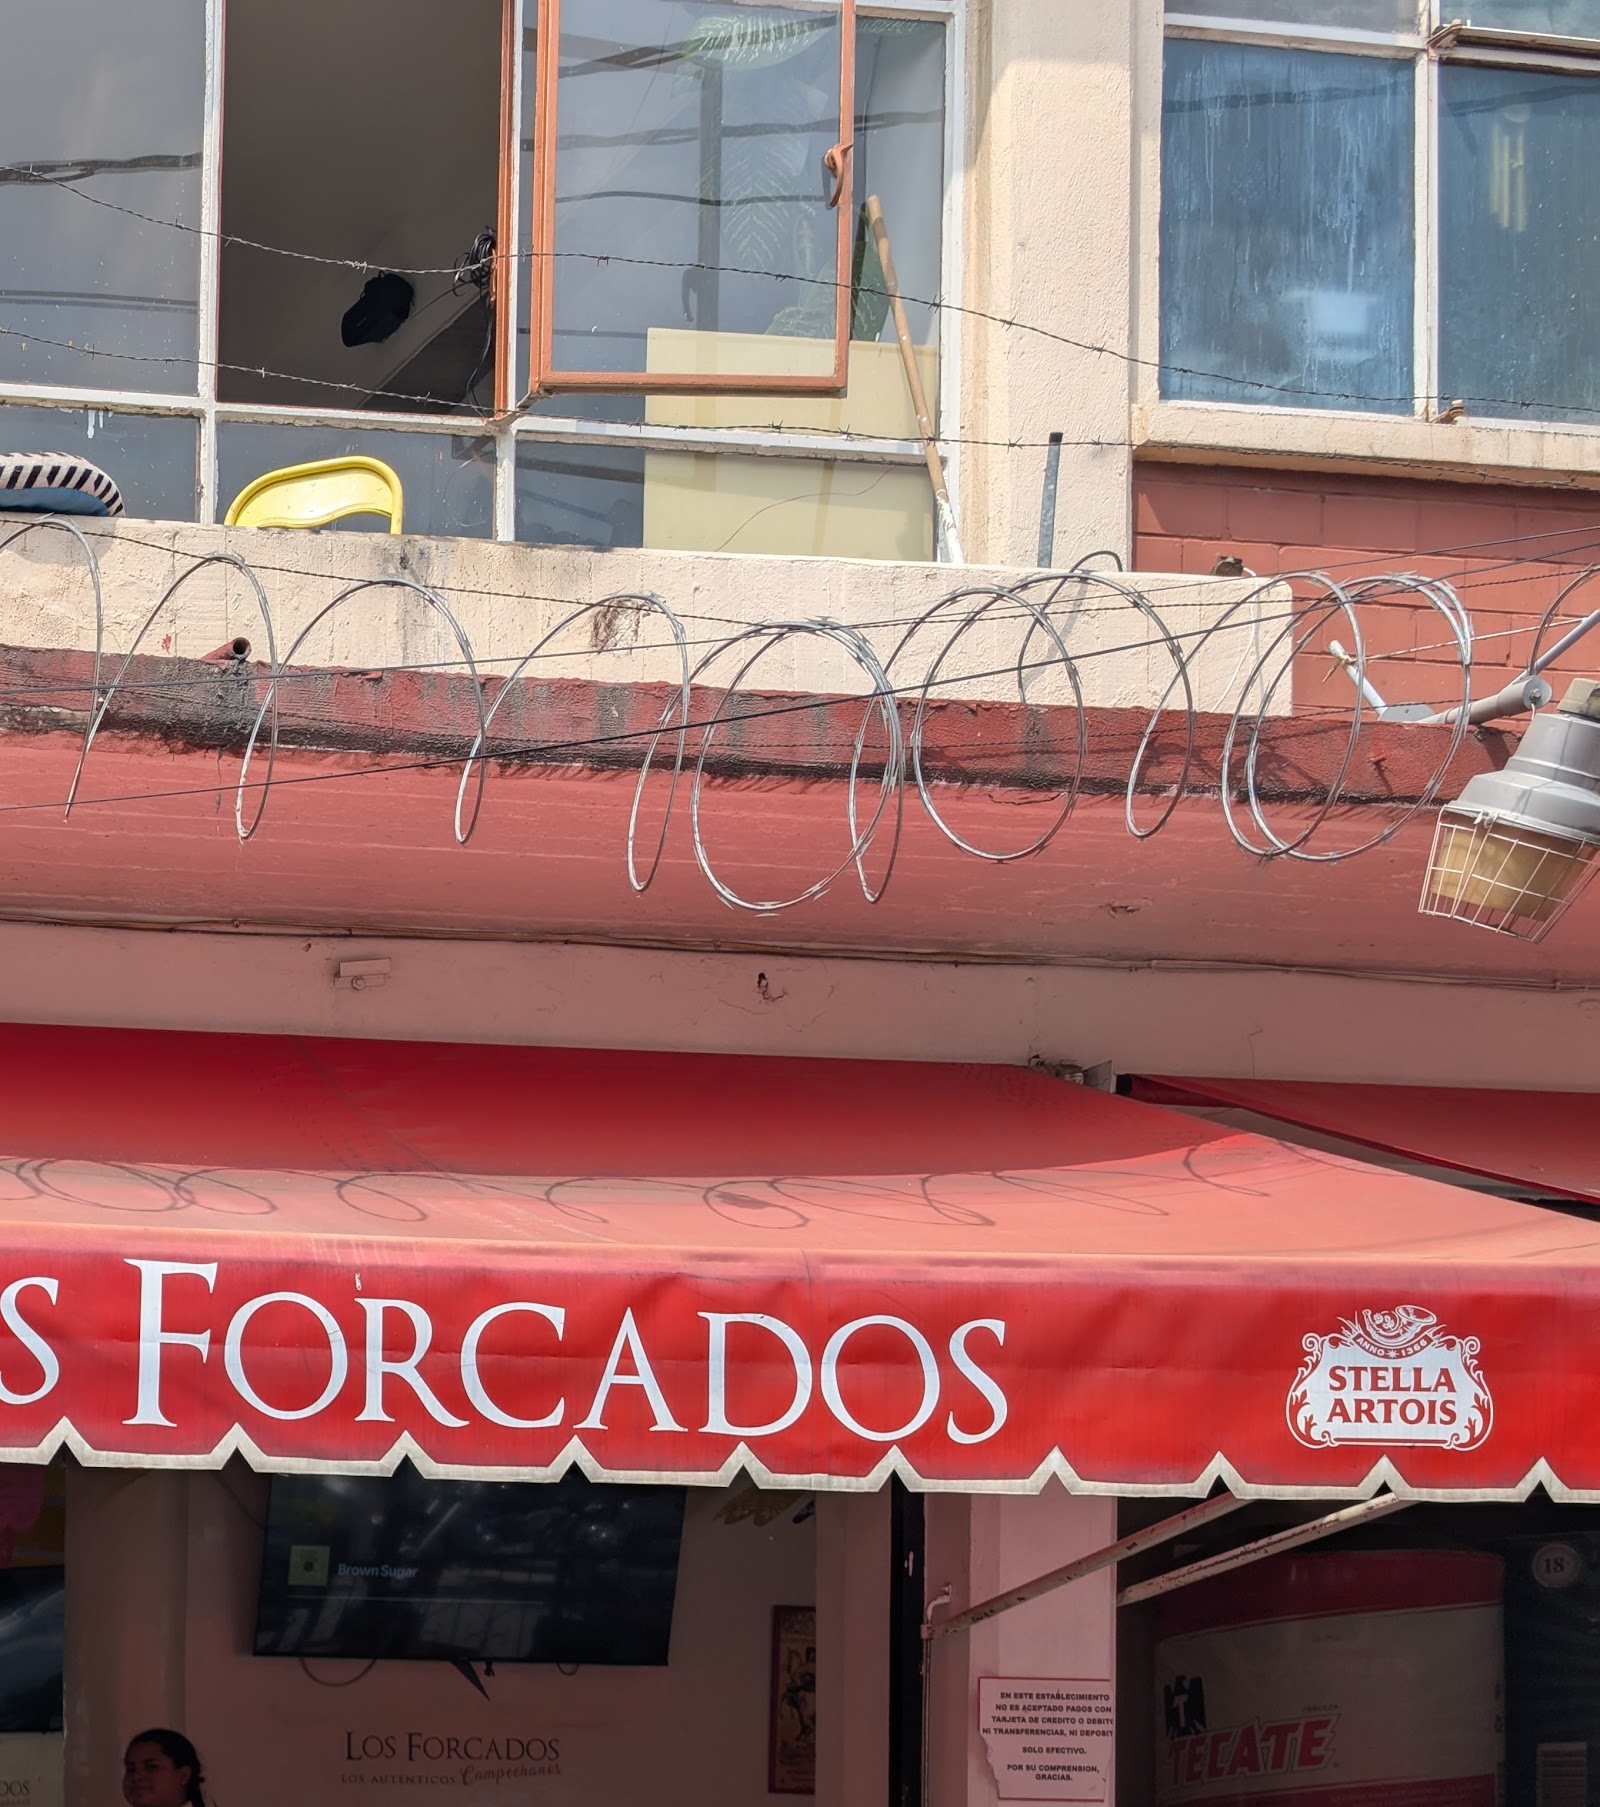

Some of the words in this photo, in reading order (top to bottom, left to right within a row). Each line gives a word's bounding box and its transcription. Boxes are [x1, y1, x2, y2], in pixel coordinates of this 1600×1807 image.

[119, 1256, 1011, 1447] FORCADOS
[1356, 1337, 1384, 1356] ANNO
[1401, 1339, 1427, 1356] 1366
[1329, 1366, 1457, 1392] STELLA
[1327, 1398, 1457, 1425] ARTOIS
[1544, 1557, 1565, 1574] 18
[1036, 1693, 1110, 1701] ESTABLECIMIENTO
[993, 1728, 1067, 1737] TRANSFERENCIAS,
[345, 1731, 396, 1760] LOS
[407, 1732, 560, 1761] FORCADOS
[1168, 1719, 1331, 1786] TECATE
[1039, 1765, 1099, 1773] COMPRENSION,
